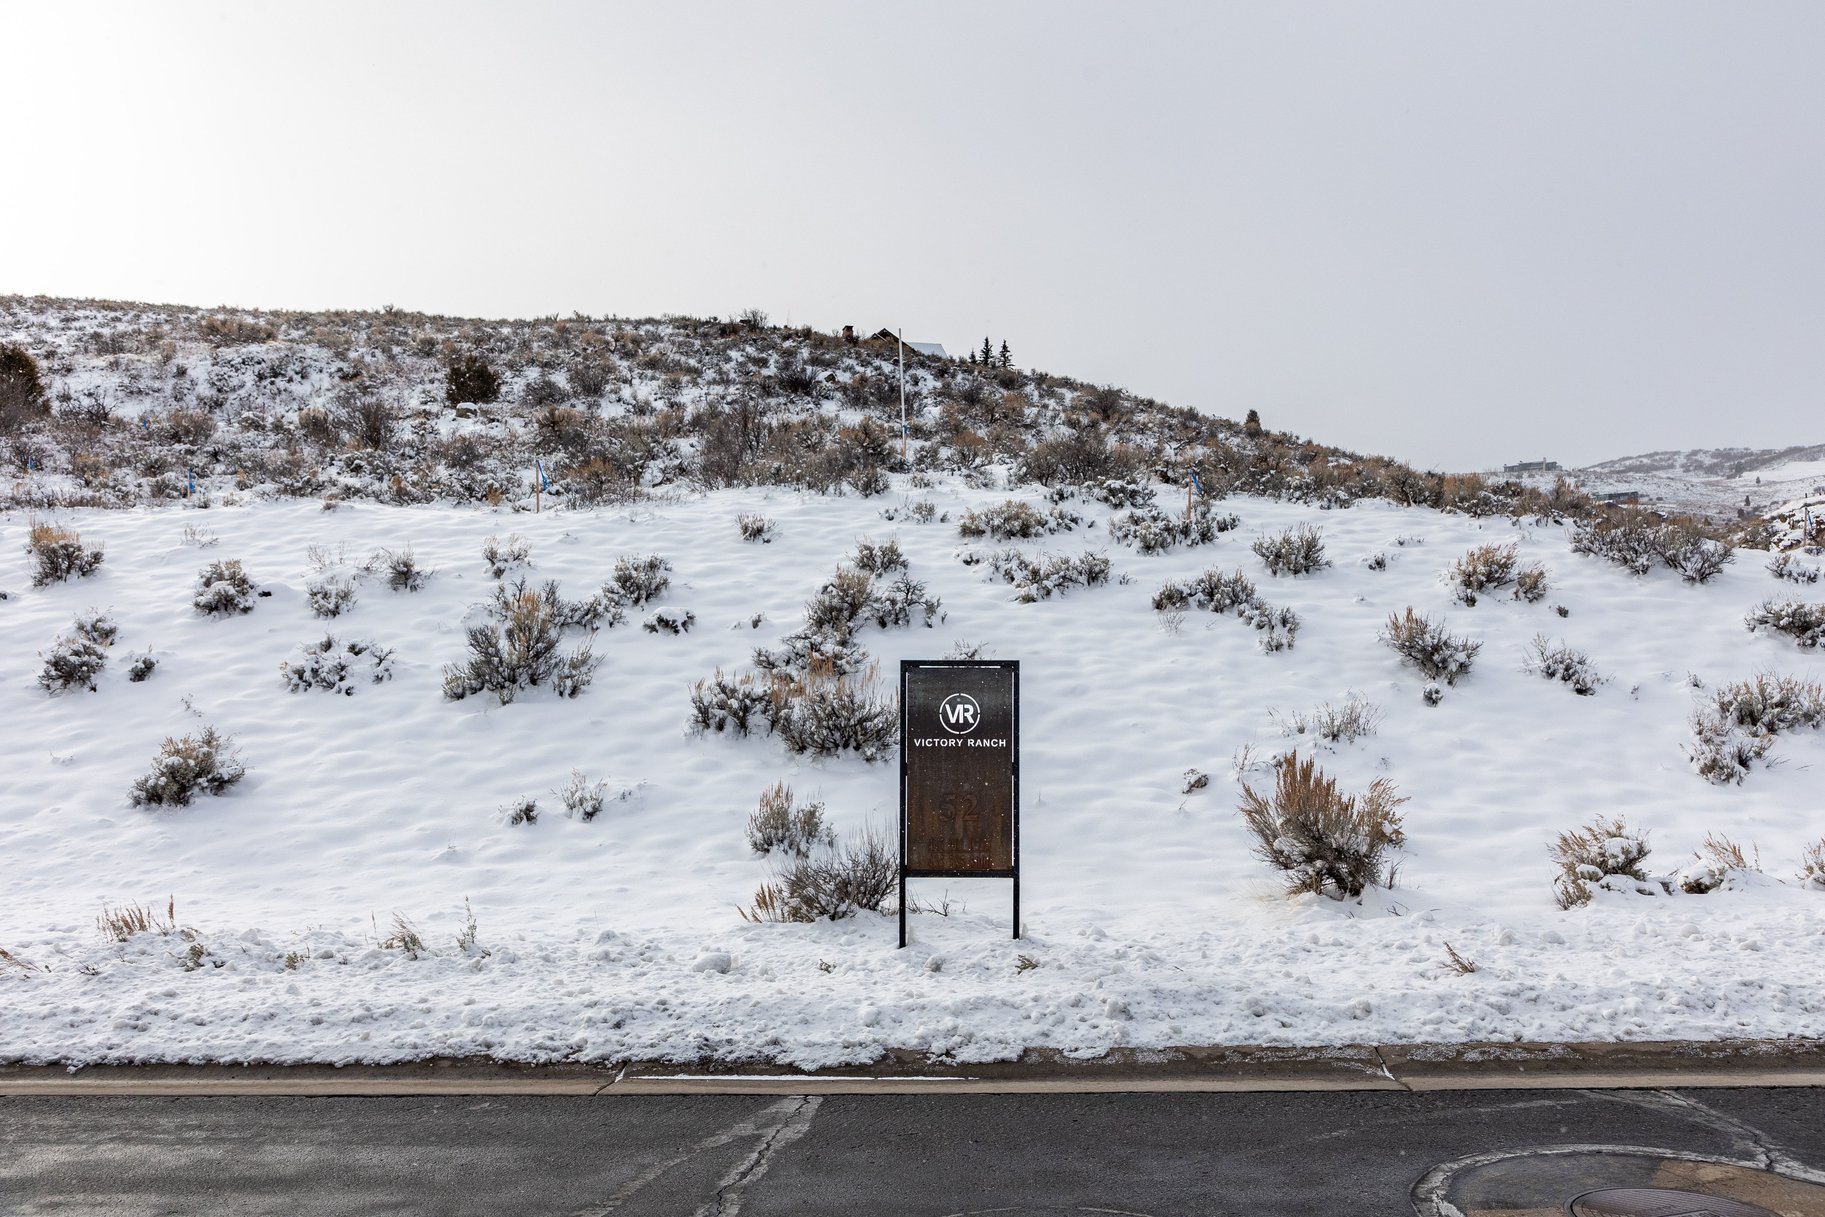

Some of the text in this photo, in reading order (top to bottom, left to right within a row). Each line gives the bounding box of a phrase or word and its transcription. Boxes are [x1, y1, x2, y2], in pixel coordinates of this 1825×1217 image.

[945, 704, 975, 724] VR
[913, 738, 1007, 747] VICTORY RANCH
